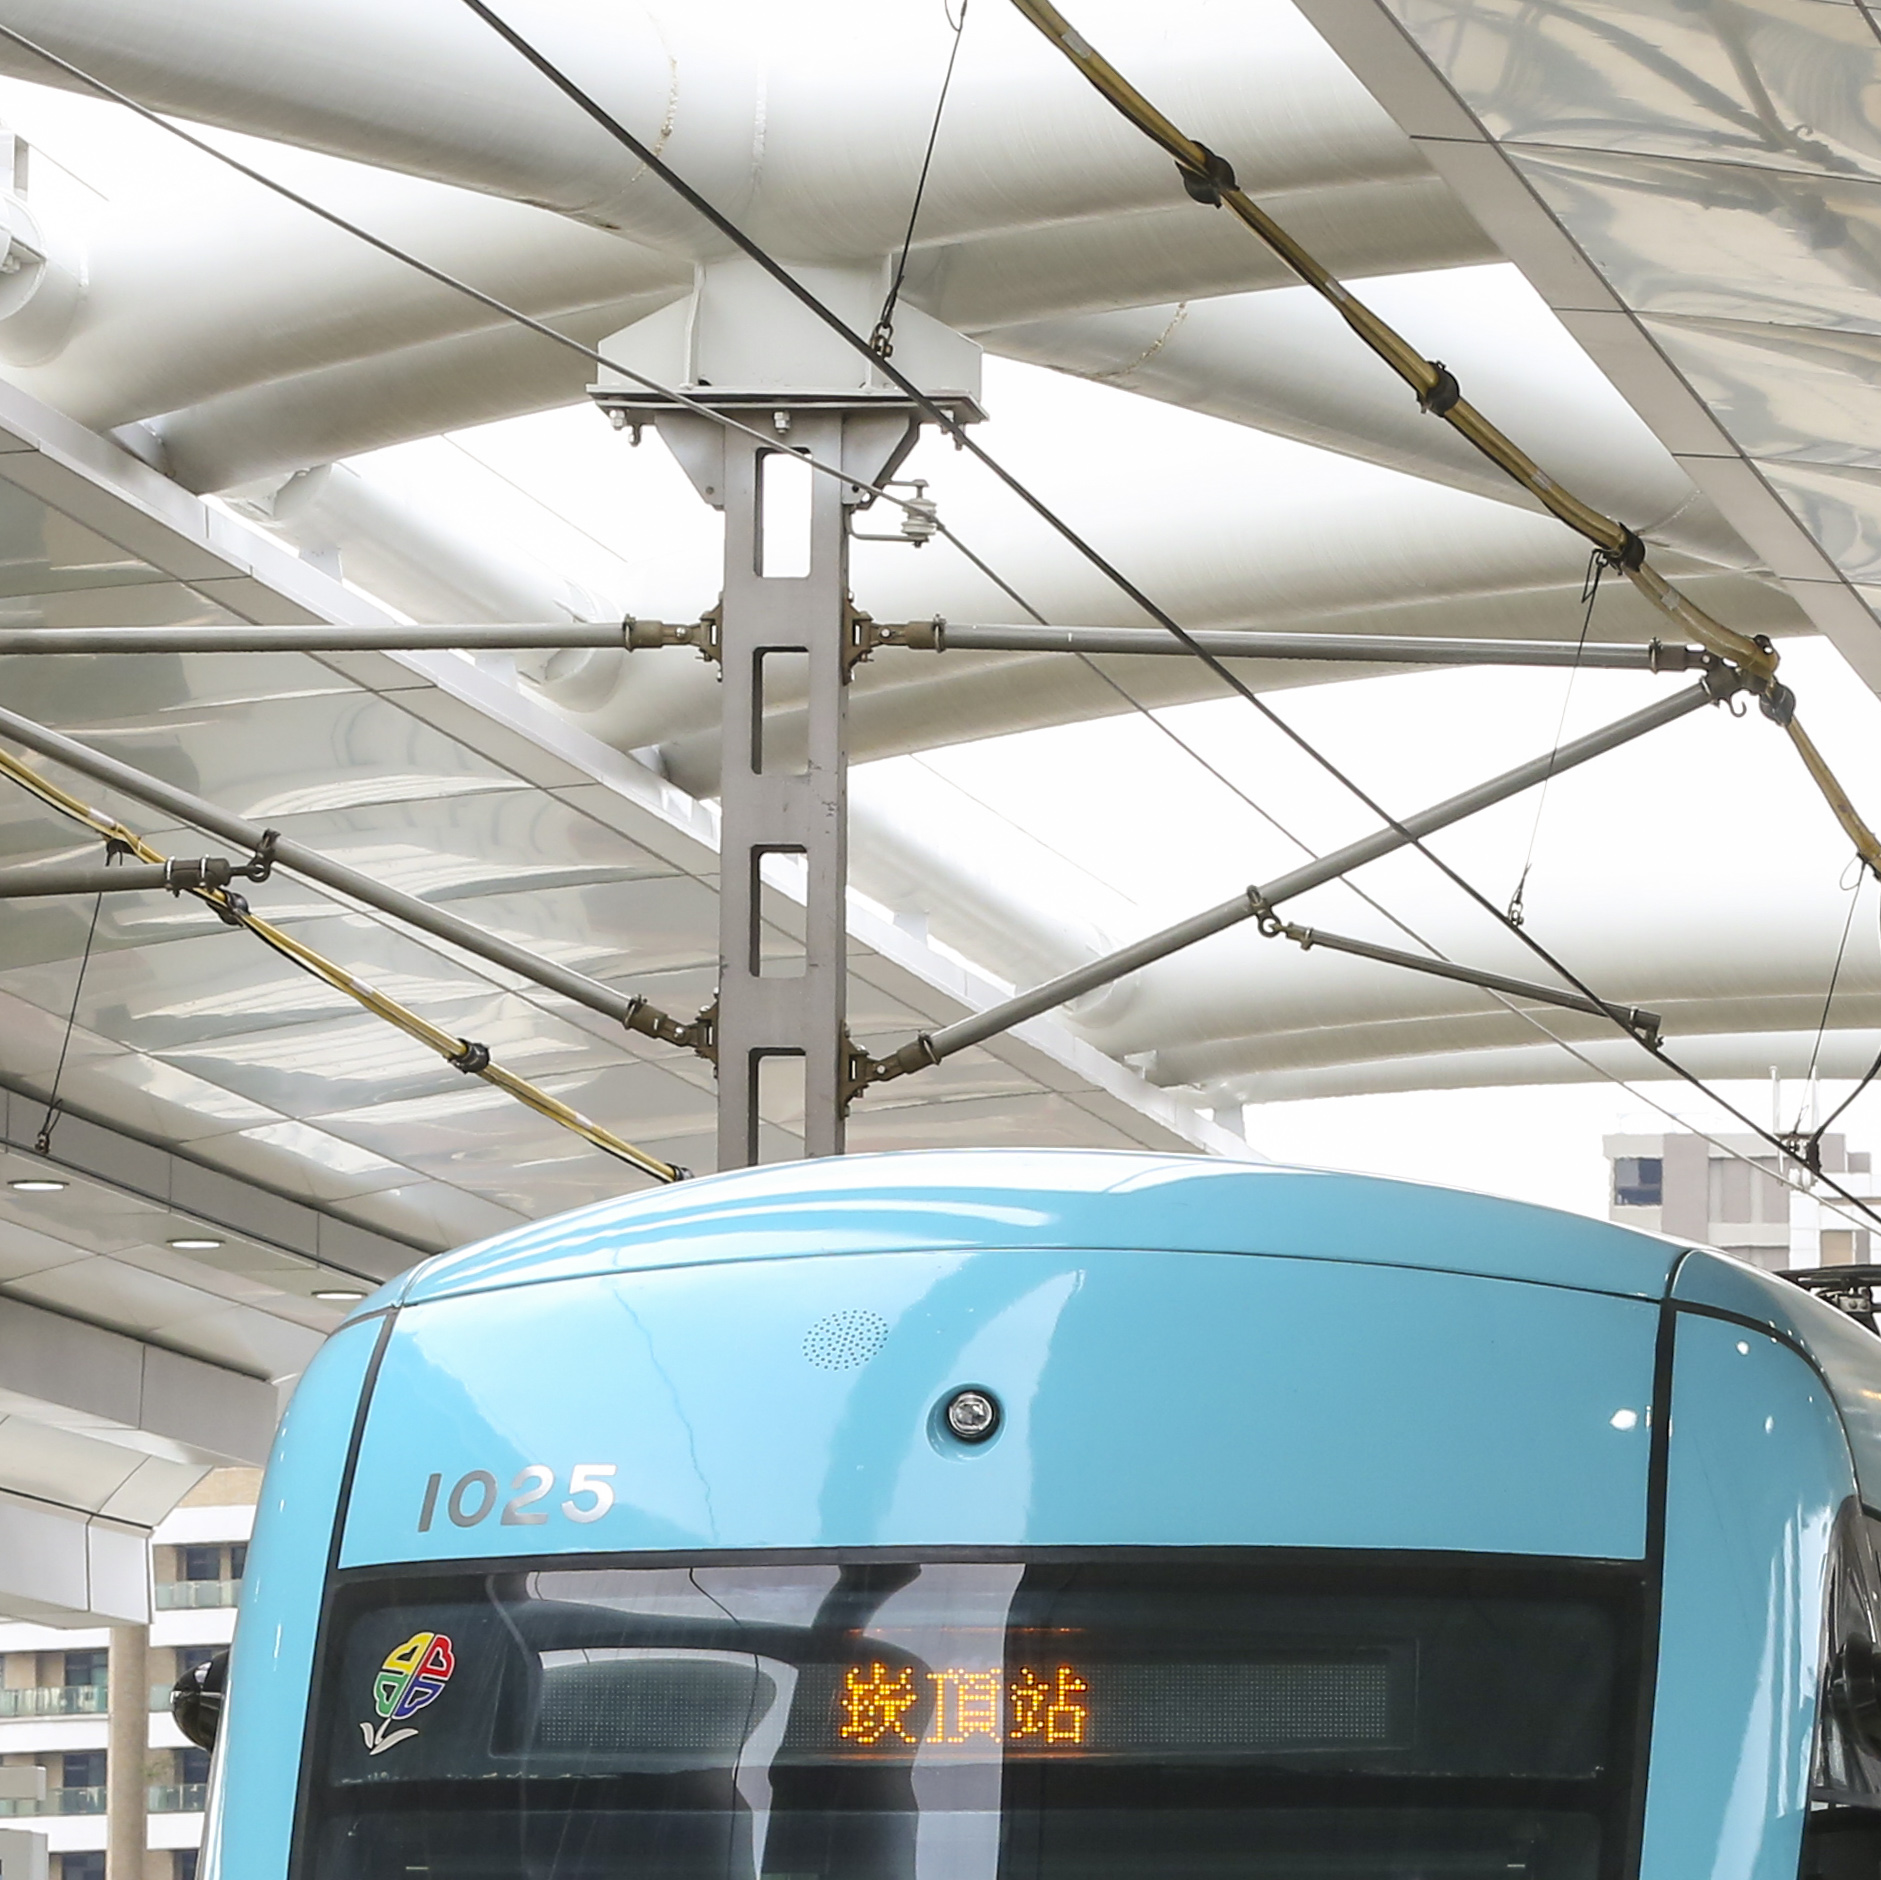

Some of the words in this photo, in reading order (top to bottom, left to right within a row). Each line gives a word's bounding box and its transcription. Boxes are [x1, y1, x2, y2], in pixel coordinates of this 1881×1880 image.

[417, 1463, 617, 1533] 1025
[839, 1661, 1088, 1745] 崁頂站
